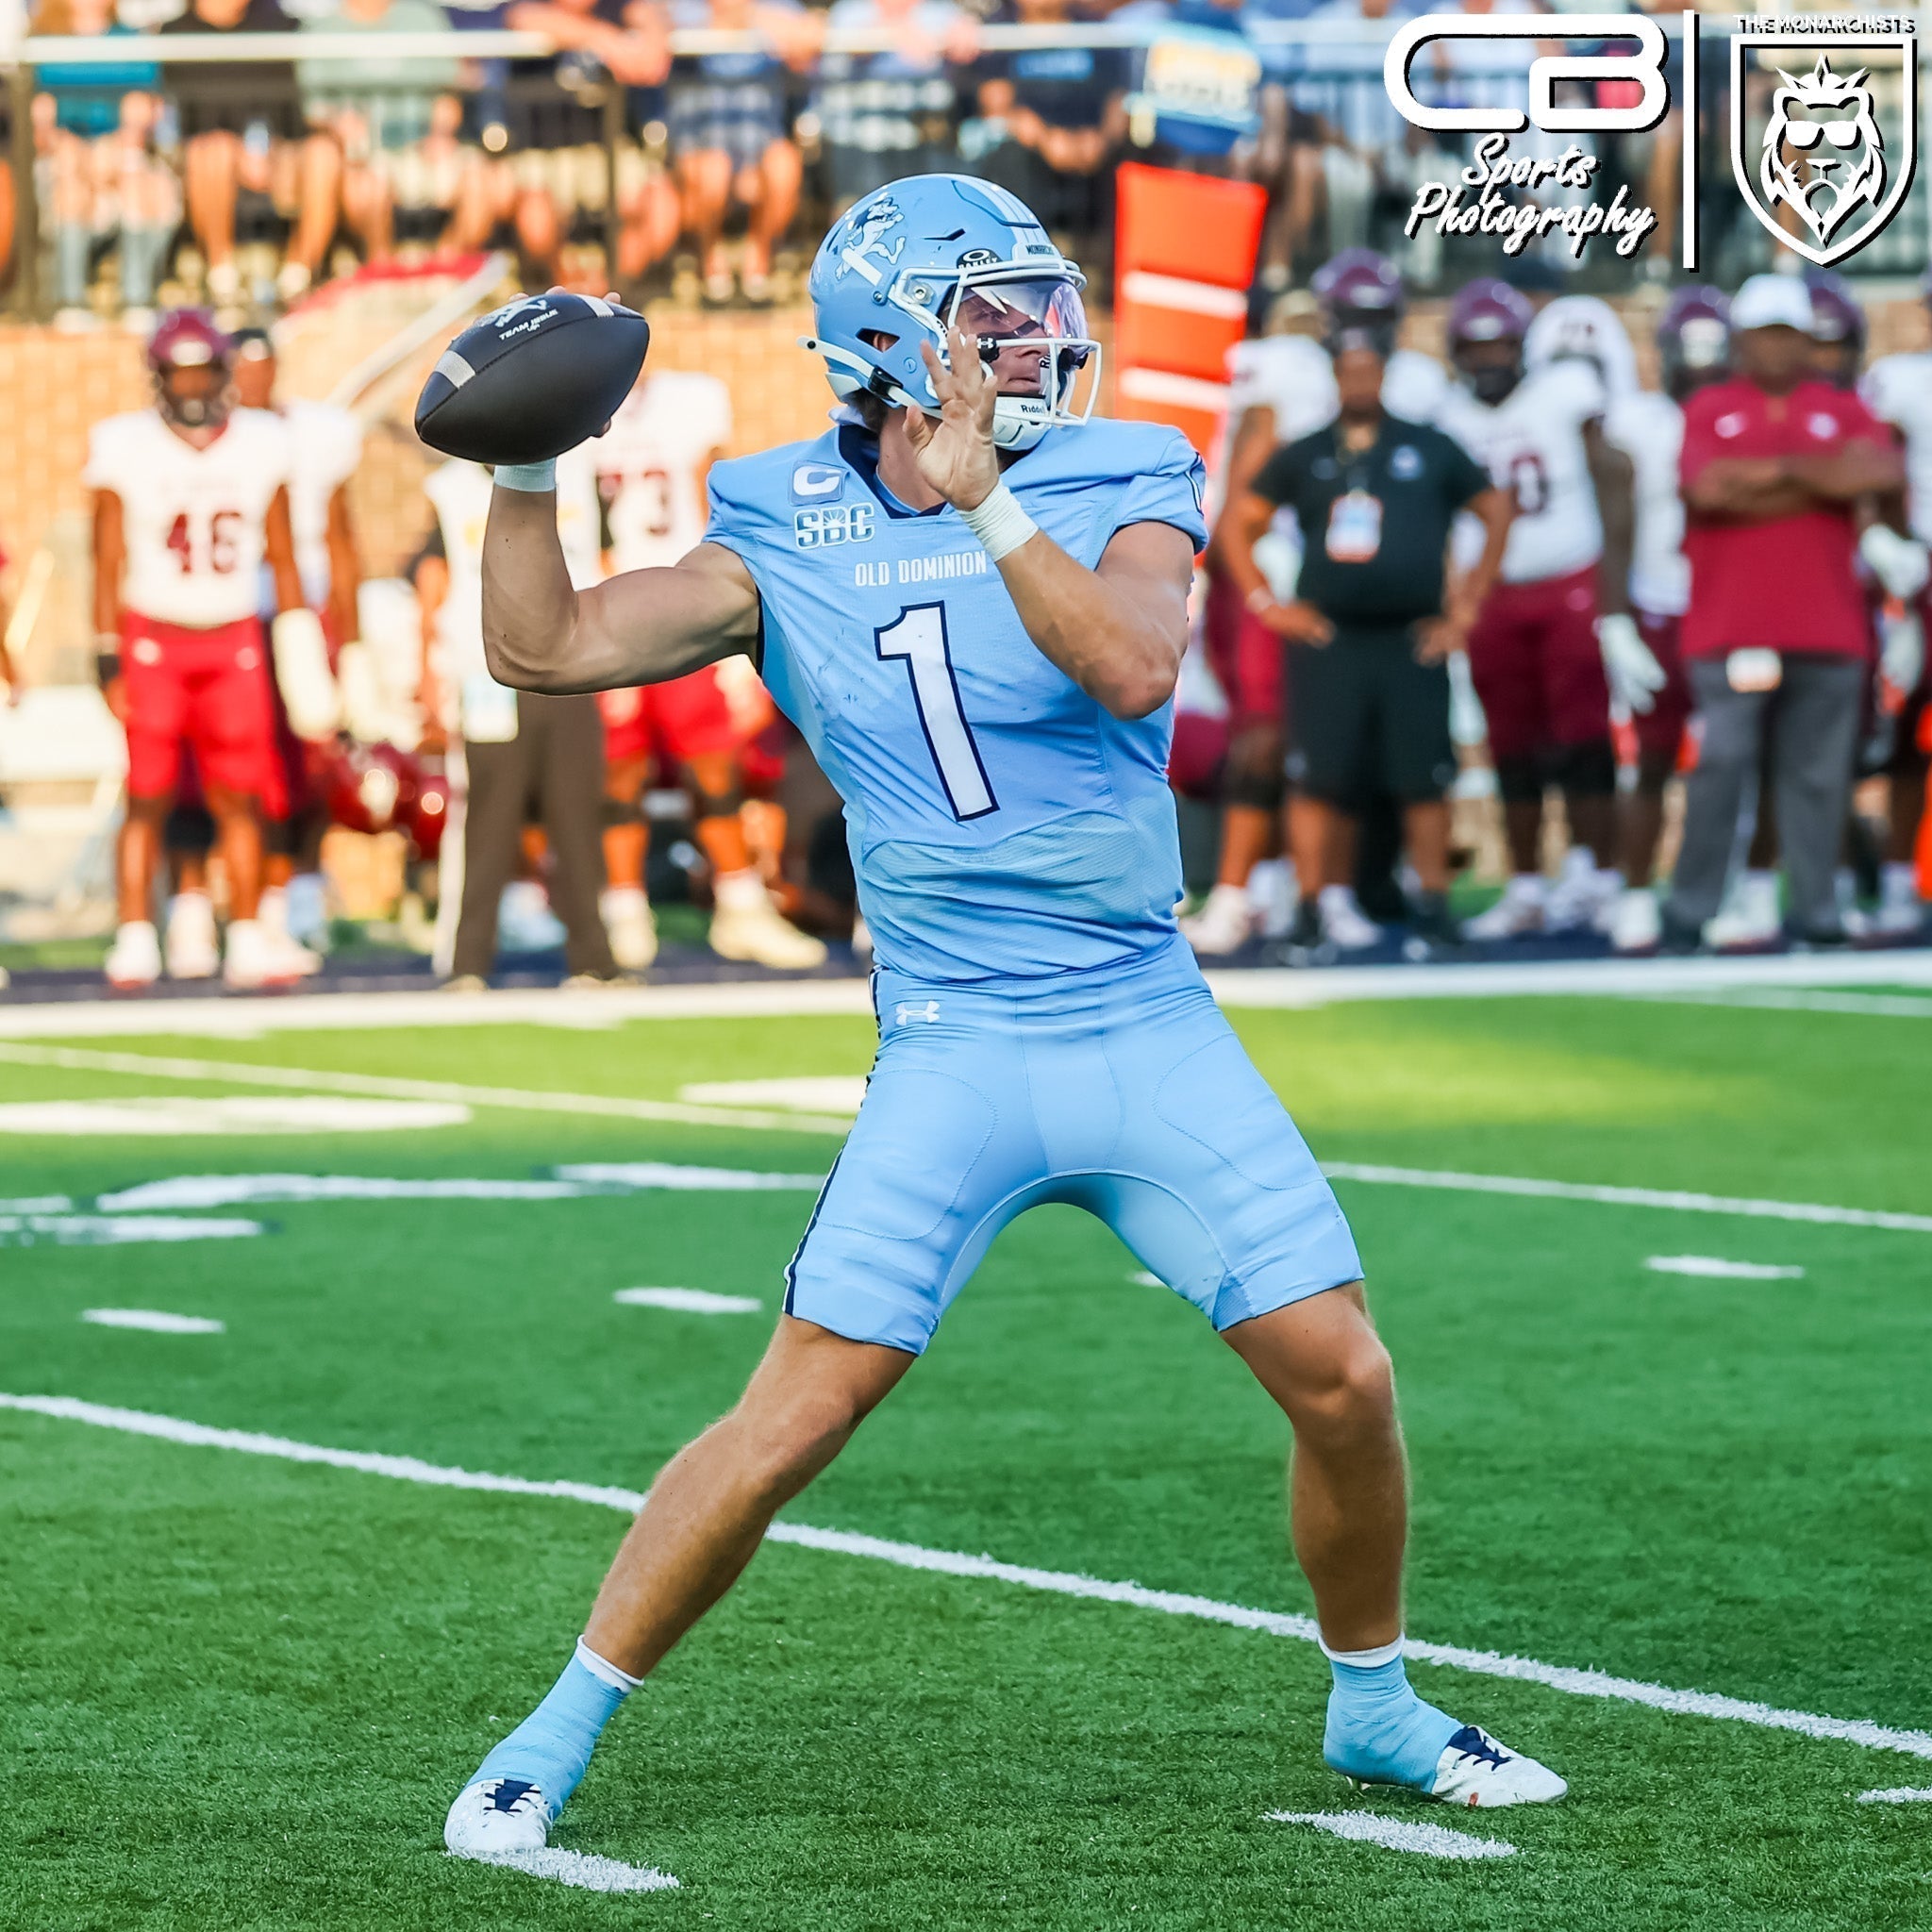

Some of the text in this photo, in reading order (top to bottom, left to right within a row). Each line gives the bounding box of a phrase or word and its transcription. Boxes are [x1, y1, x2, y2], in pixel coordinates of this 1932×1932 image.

[499, 322, 528, 341] TEAM
[793, 465, 841, 496] C
[166, 510, 242, 575] 46
[794, 502, 875, 551] SBC
[854, 549, 988, 588] OLD DOMINION
[874, 600, 1001, 823] 1
